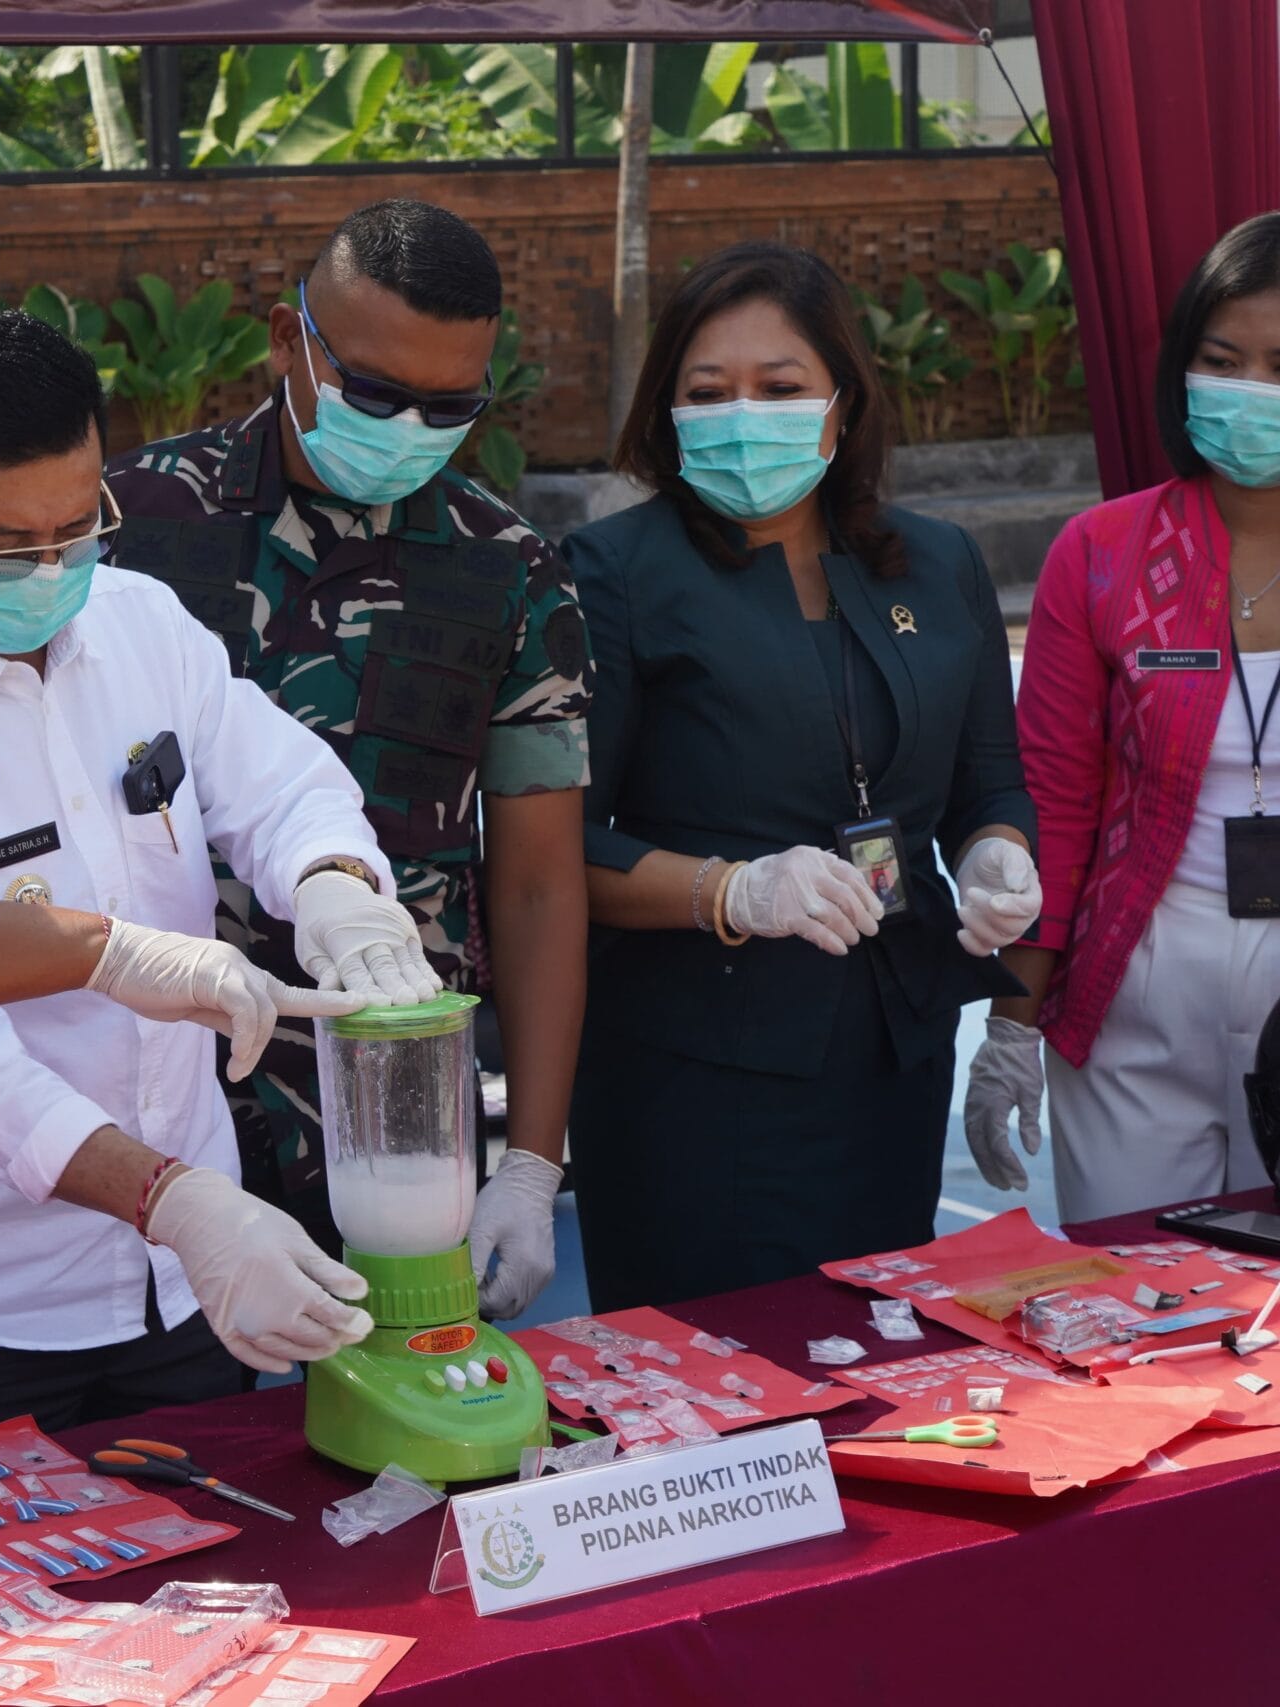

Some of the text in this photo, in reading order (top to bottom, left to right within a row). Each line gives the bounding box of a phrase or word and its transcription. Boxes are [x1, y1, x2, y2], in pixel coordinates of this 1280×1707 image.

[431, 1330, 463, 1341] MOTOR
[431, 1340, 464, 1351] SAFETY
[552, 1445, 827, 1527] BARANG BUKTI TINDAK
[580, 1482, 818, 1556] PIDANA NARKOTIKA
